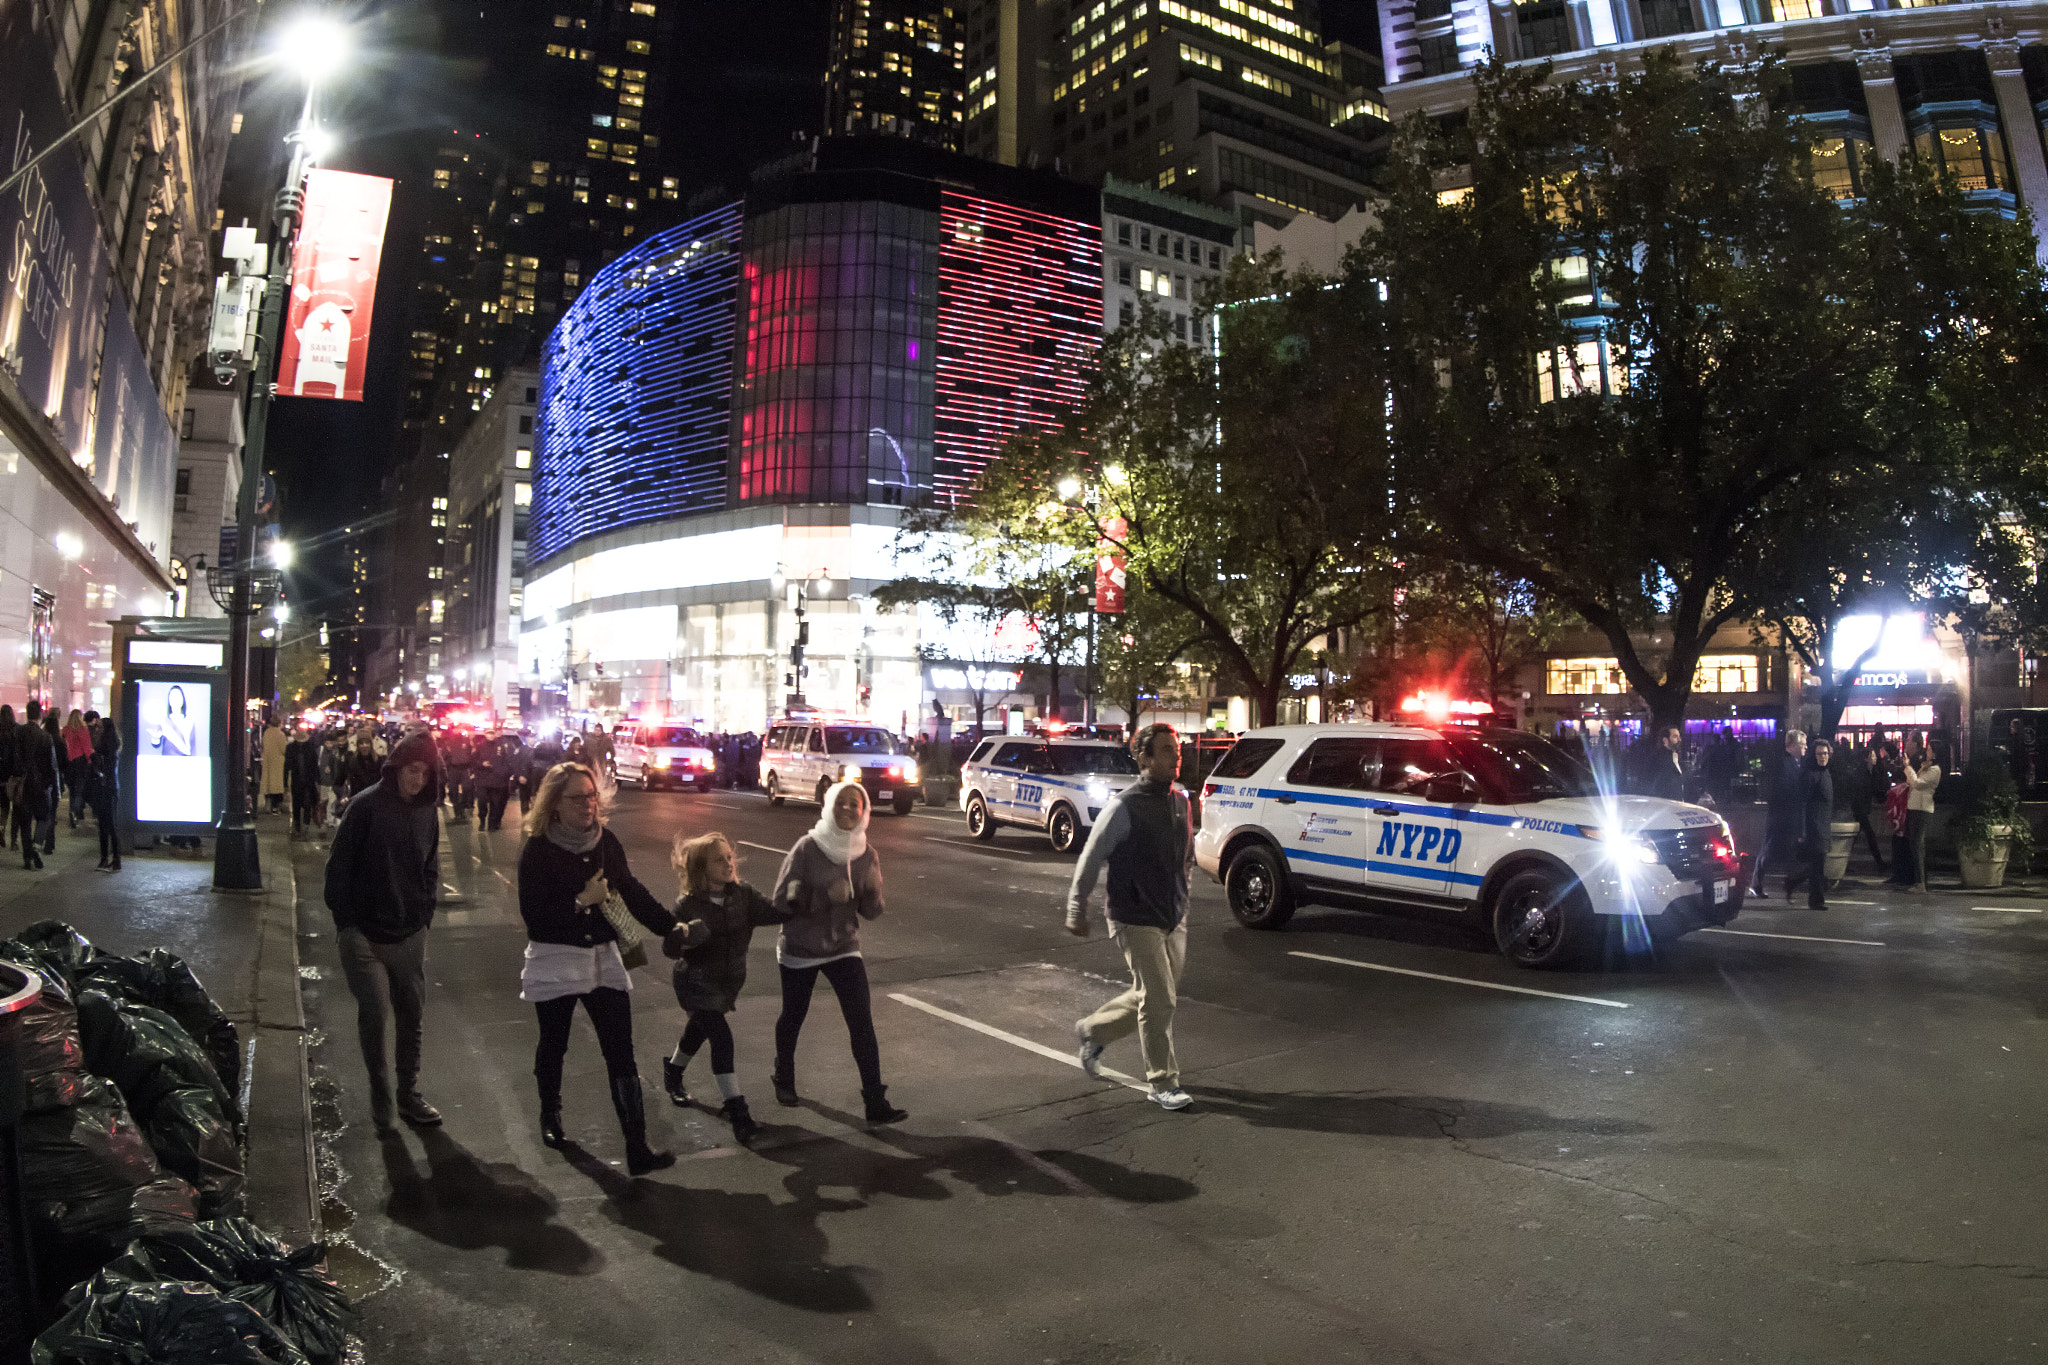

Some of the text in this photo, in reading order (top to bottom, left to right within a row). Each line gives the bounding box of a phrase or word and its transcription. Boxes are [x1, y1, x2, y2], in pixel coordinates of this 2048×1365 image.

[12, 108, 77, 309] VICTORIA'S
[8, 218, 60, 352] SECRET
[310, 343, 337, 352] SANTA
[312, 355, 333, 364] MAIL
[1861, 671, 1908, 689] macy's
[1016, 783, 1043, 803] NYPD
[1522, 816, 1563, 834] POLICE
[1375, 821, 1462, 864] NYPD
